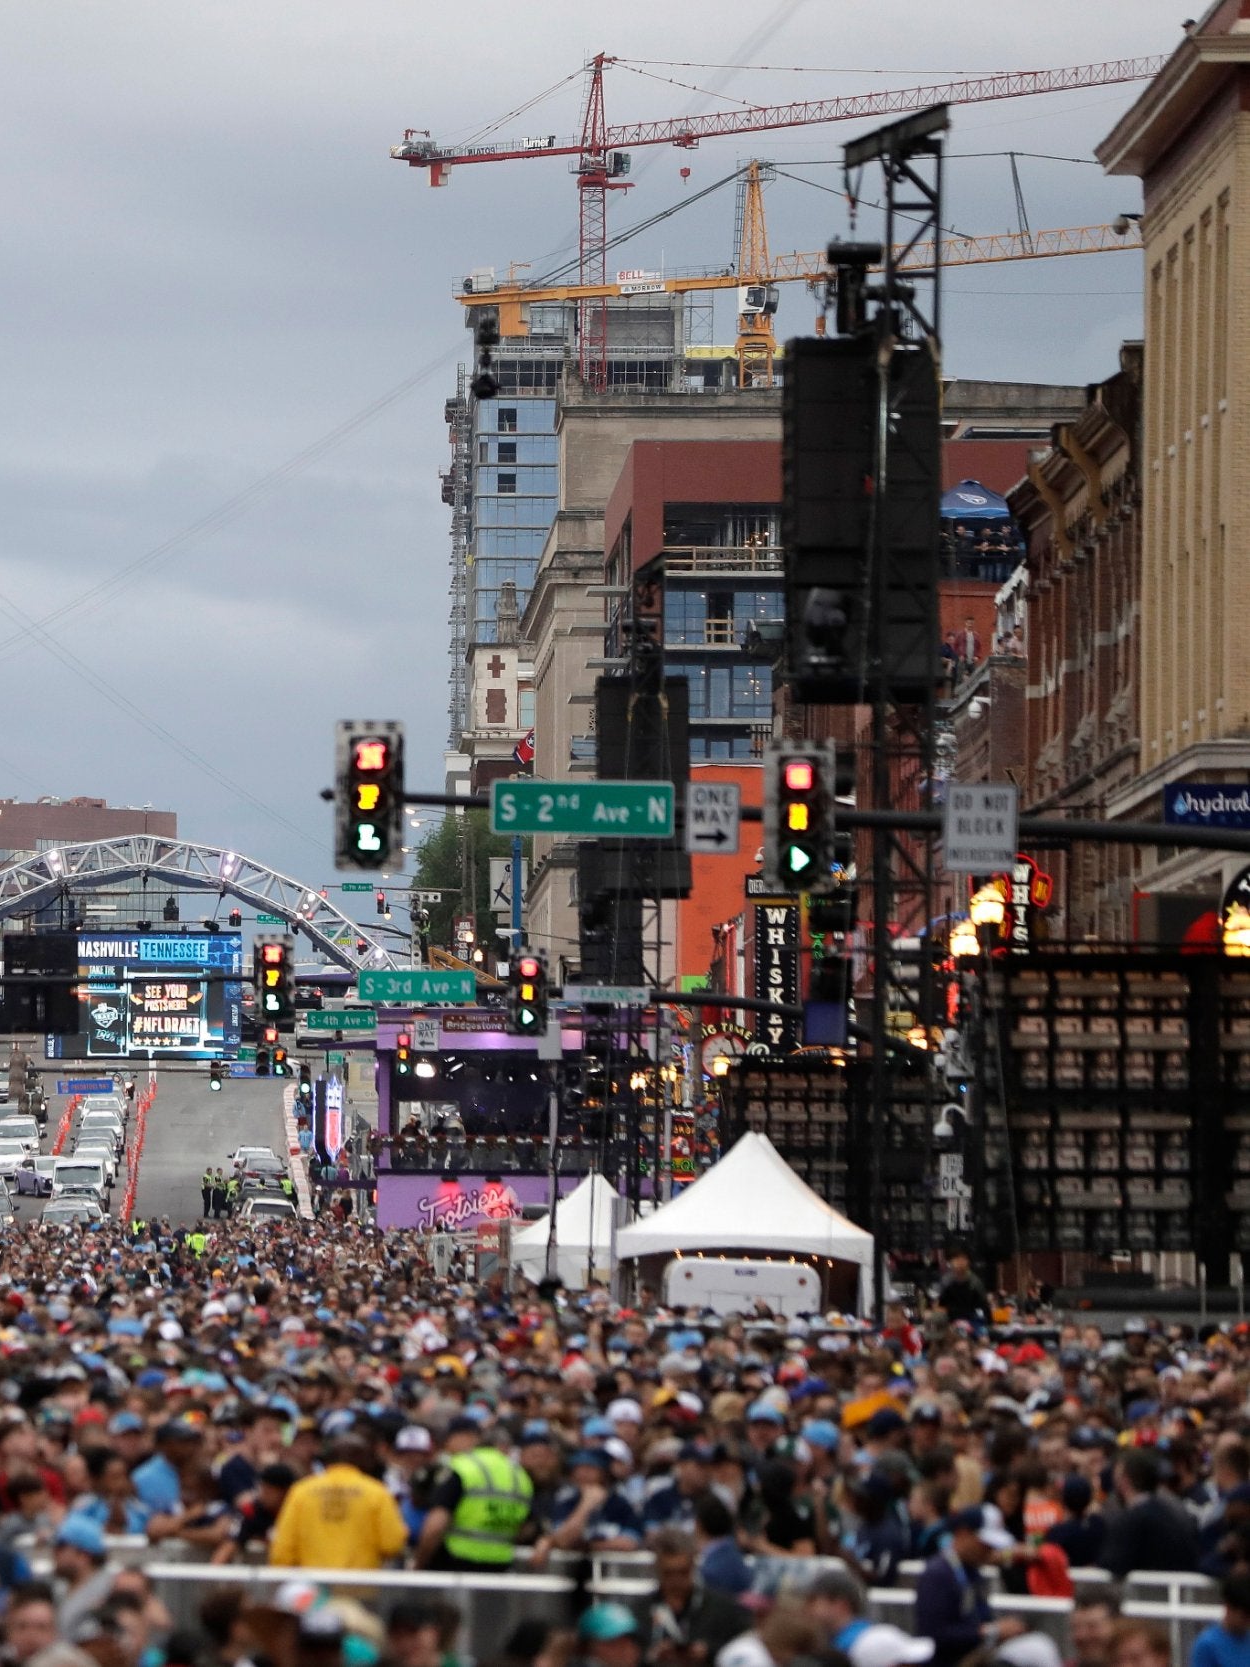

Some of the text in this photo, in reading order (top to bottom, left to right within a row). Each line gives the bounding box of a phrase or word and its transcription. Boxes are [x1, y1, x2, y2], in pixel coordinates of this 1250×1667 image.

[618, 270, 643, 281] BELL
[631, 284, 662, 292] MORROW
[694, 787, 733, 806] ONE
[954, 794, 973, 810] DO
[694, 808, 733, 825] WAY
[957, 817, 1005, 834] BLOCK
[78, 941, 206, 957] NASHVILLE TENNESSEE
[765, 908, 788, 1044] WHISKEY
[145, 984, 188, 998] SEE YOUR
[133, 1017, 200, 1033] #NFLDRAFT
[418, 1023, 435, 1031] ONE
[446, 1021, 502, 1031] Bridgestone
[702, 1022, 753, 1039] IG TIME
[418, 1031, 435, 1039] WAY
